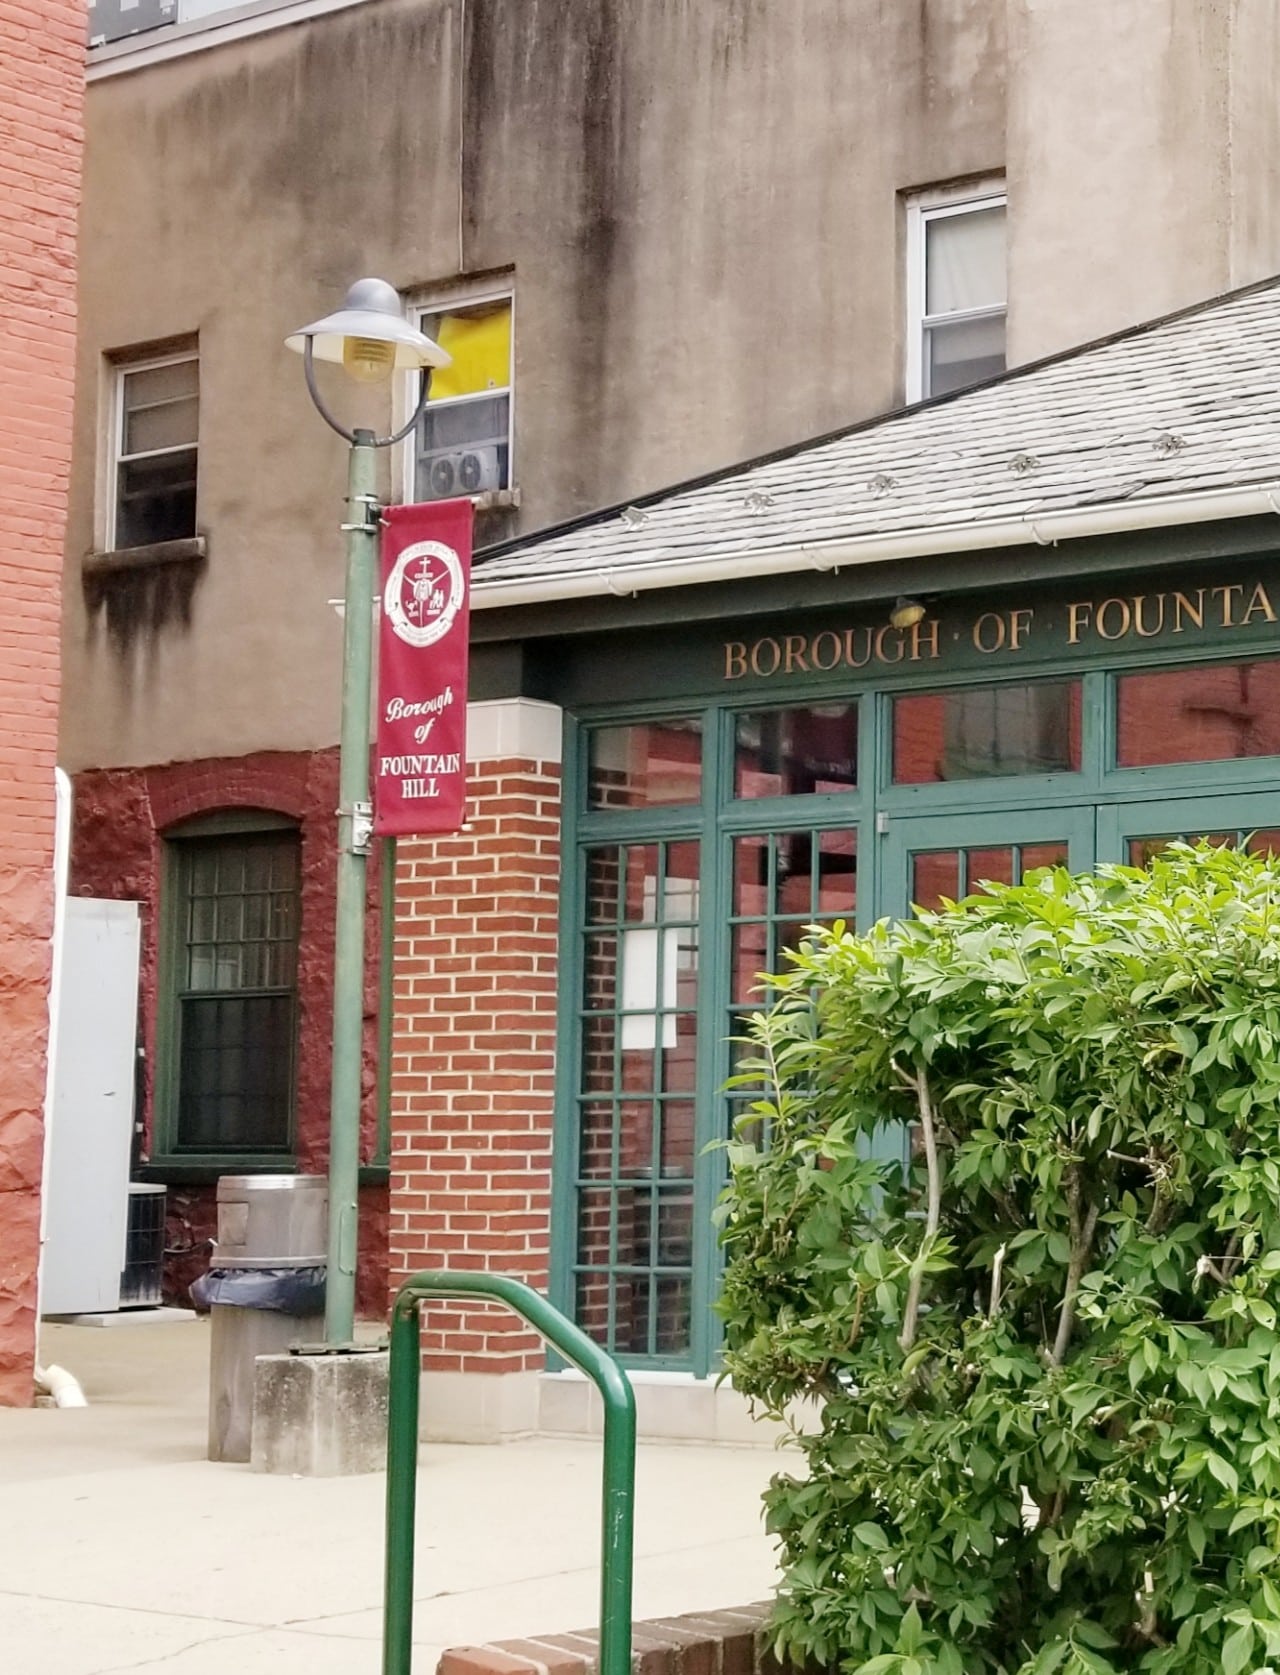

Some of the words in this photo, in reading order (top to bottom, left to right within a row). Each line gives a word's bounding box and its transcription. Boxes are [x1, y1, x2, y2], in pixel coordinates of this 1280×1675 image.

[724, 619, 940, 680] BOROUGH
[973, 608, 1034, 654] OF
[385, 686, 453, 722] Borough
[414, 717, 435, 744] of
[380, 753, 460, 776] FOUNTAIN
[402, 778, 439, 798] HILL
